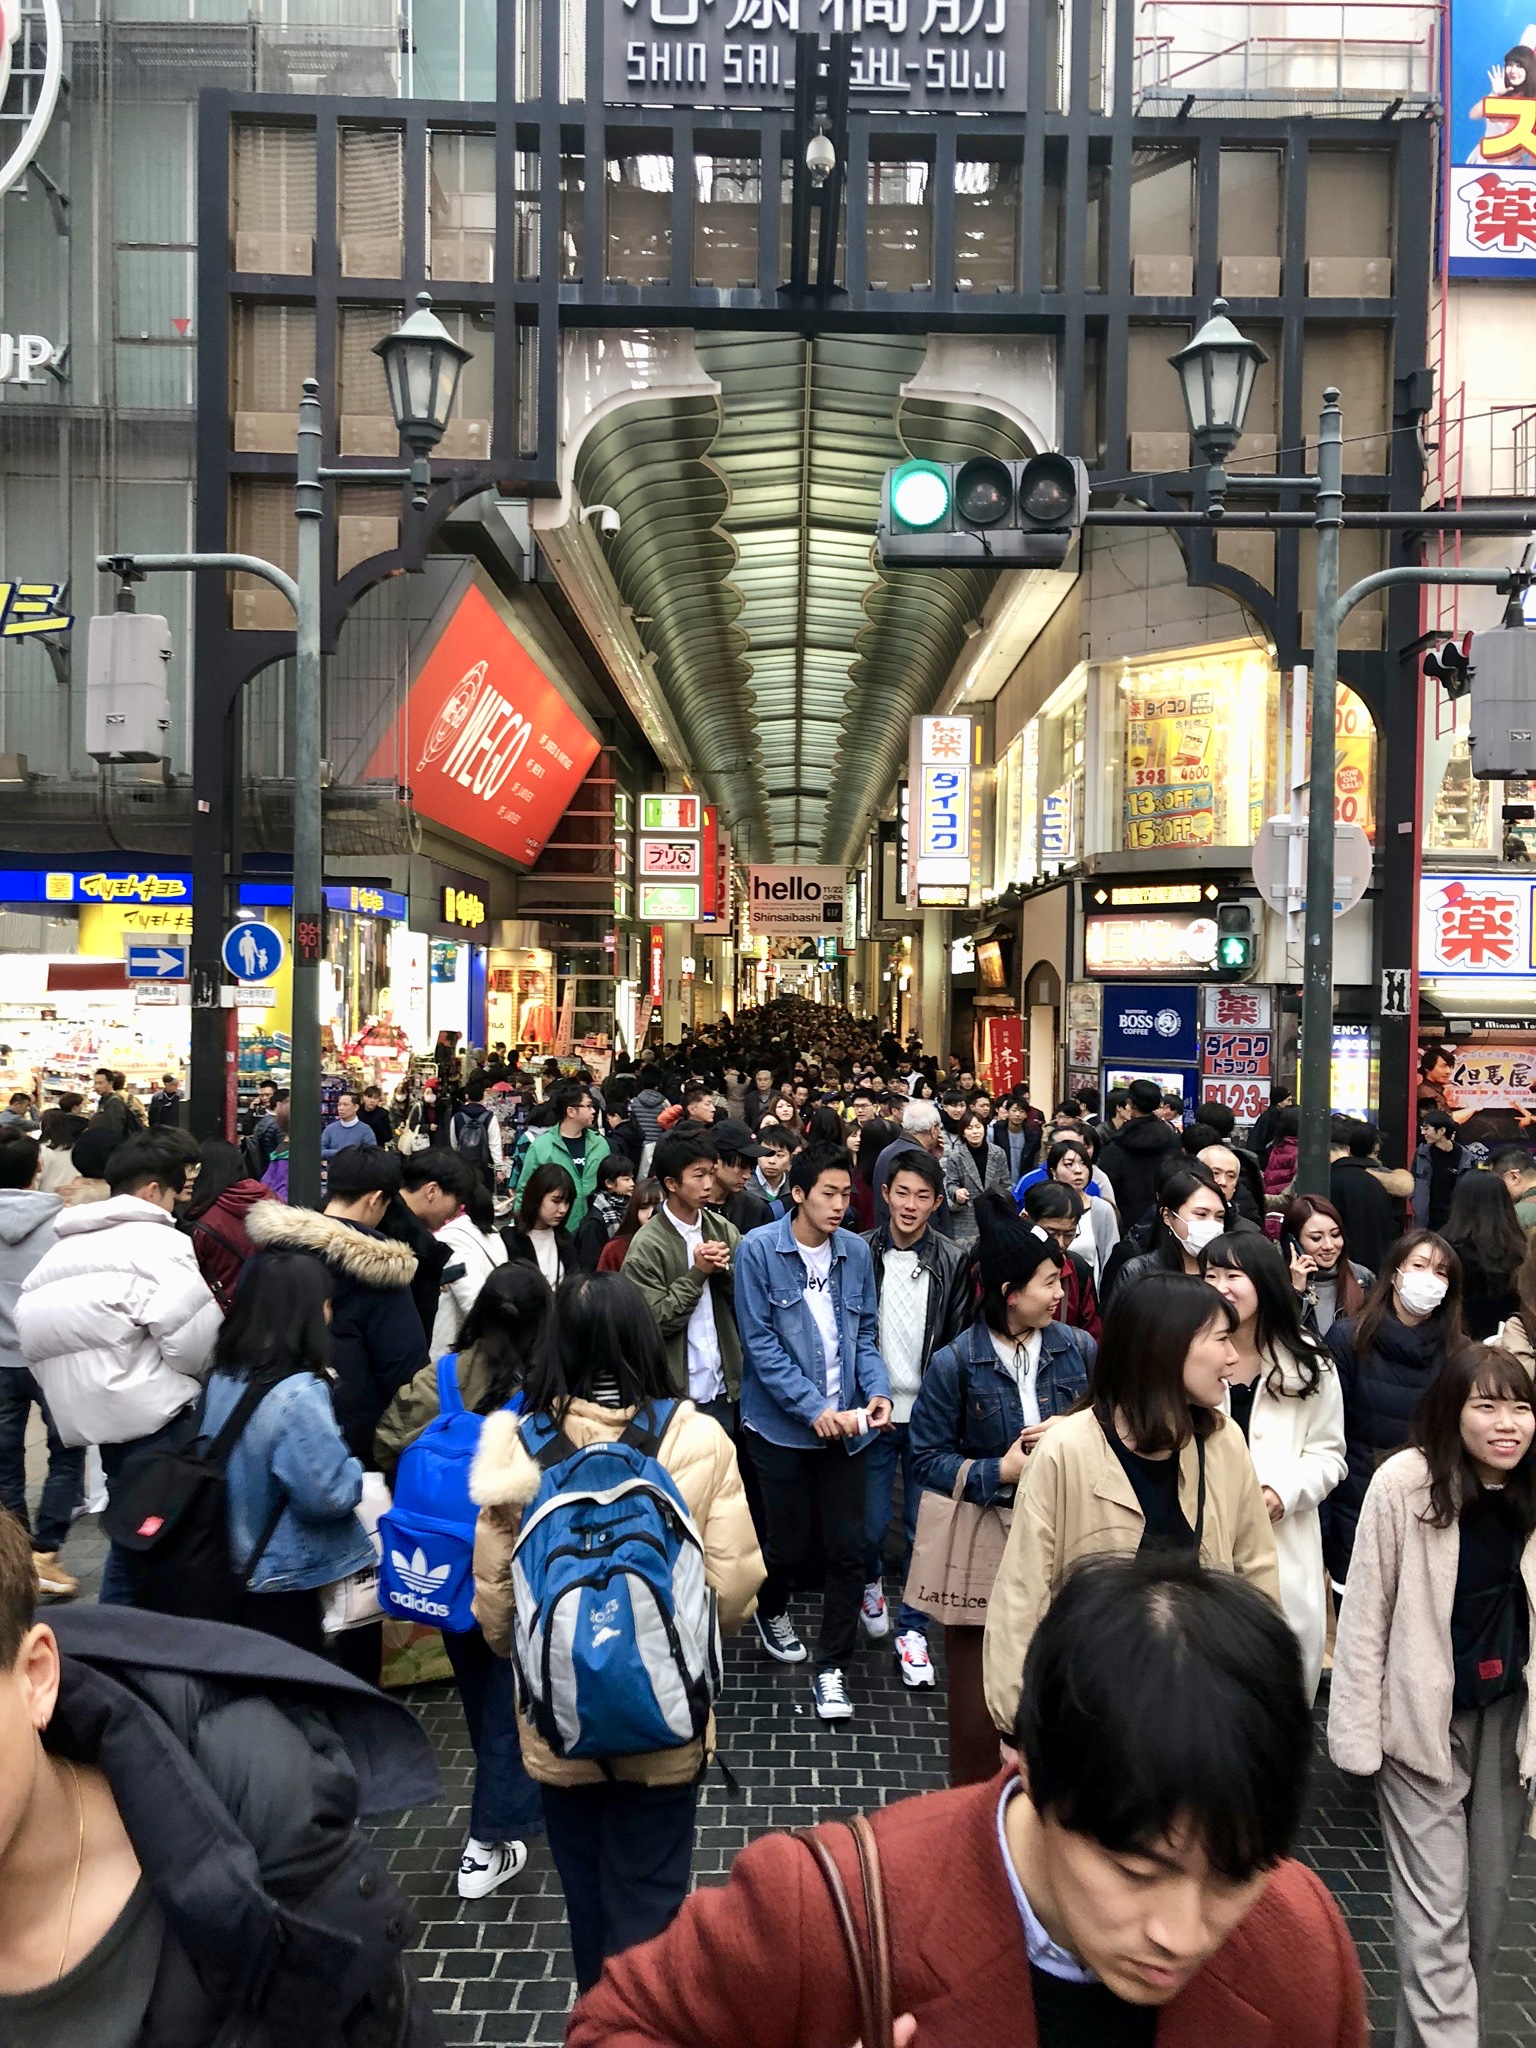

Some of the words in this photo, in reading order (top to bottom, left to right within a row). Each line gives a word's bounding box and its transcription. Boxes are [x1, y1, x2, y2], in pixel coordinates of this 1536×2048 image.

[723, 44, 779, 84] SAI
[441, 684, 533, 801] WEGO
[931, 721, 962, 757] 薬
[1136, 769, 1166, 785] 398
[1181, 765, 1210, 781] 4600
[1340, 769, 1358, 778] NOW
[1341, 782, 1362, 790] SALE!
[931, 772, 959, 849] ダイコク
[754, 876, 821, 900] hello
[753, 912, 821, 922] Shinsaibashi
[1441, 896, 1514, 963] 薬
[1218, 994, 1258, 1025] 薬
[1119, 1015, 1154, 1028] BOSS
[1485, 1021, 1520, 1029] Minami
[1206, 1036, 1269, 1057] ダイコク
[1213, 1058, 1258, 1074] ドラッグ
[1453, 1063, 1532, 1088] 但馬屋
[390, 1591, 450, 1617] adidas
[917, 1586, 987, 1608] Lattice
